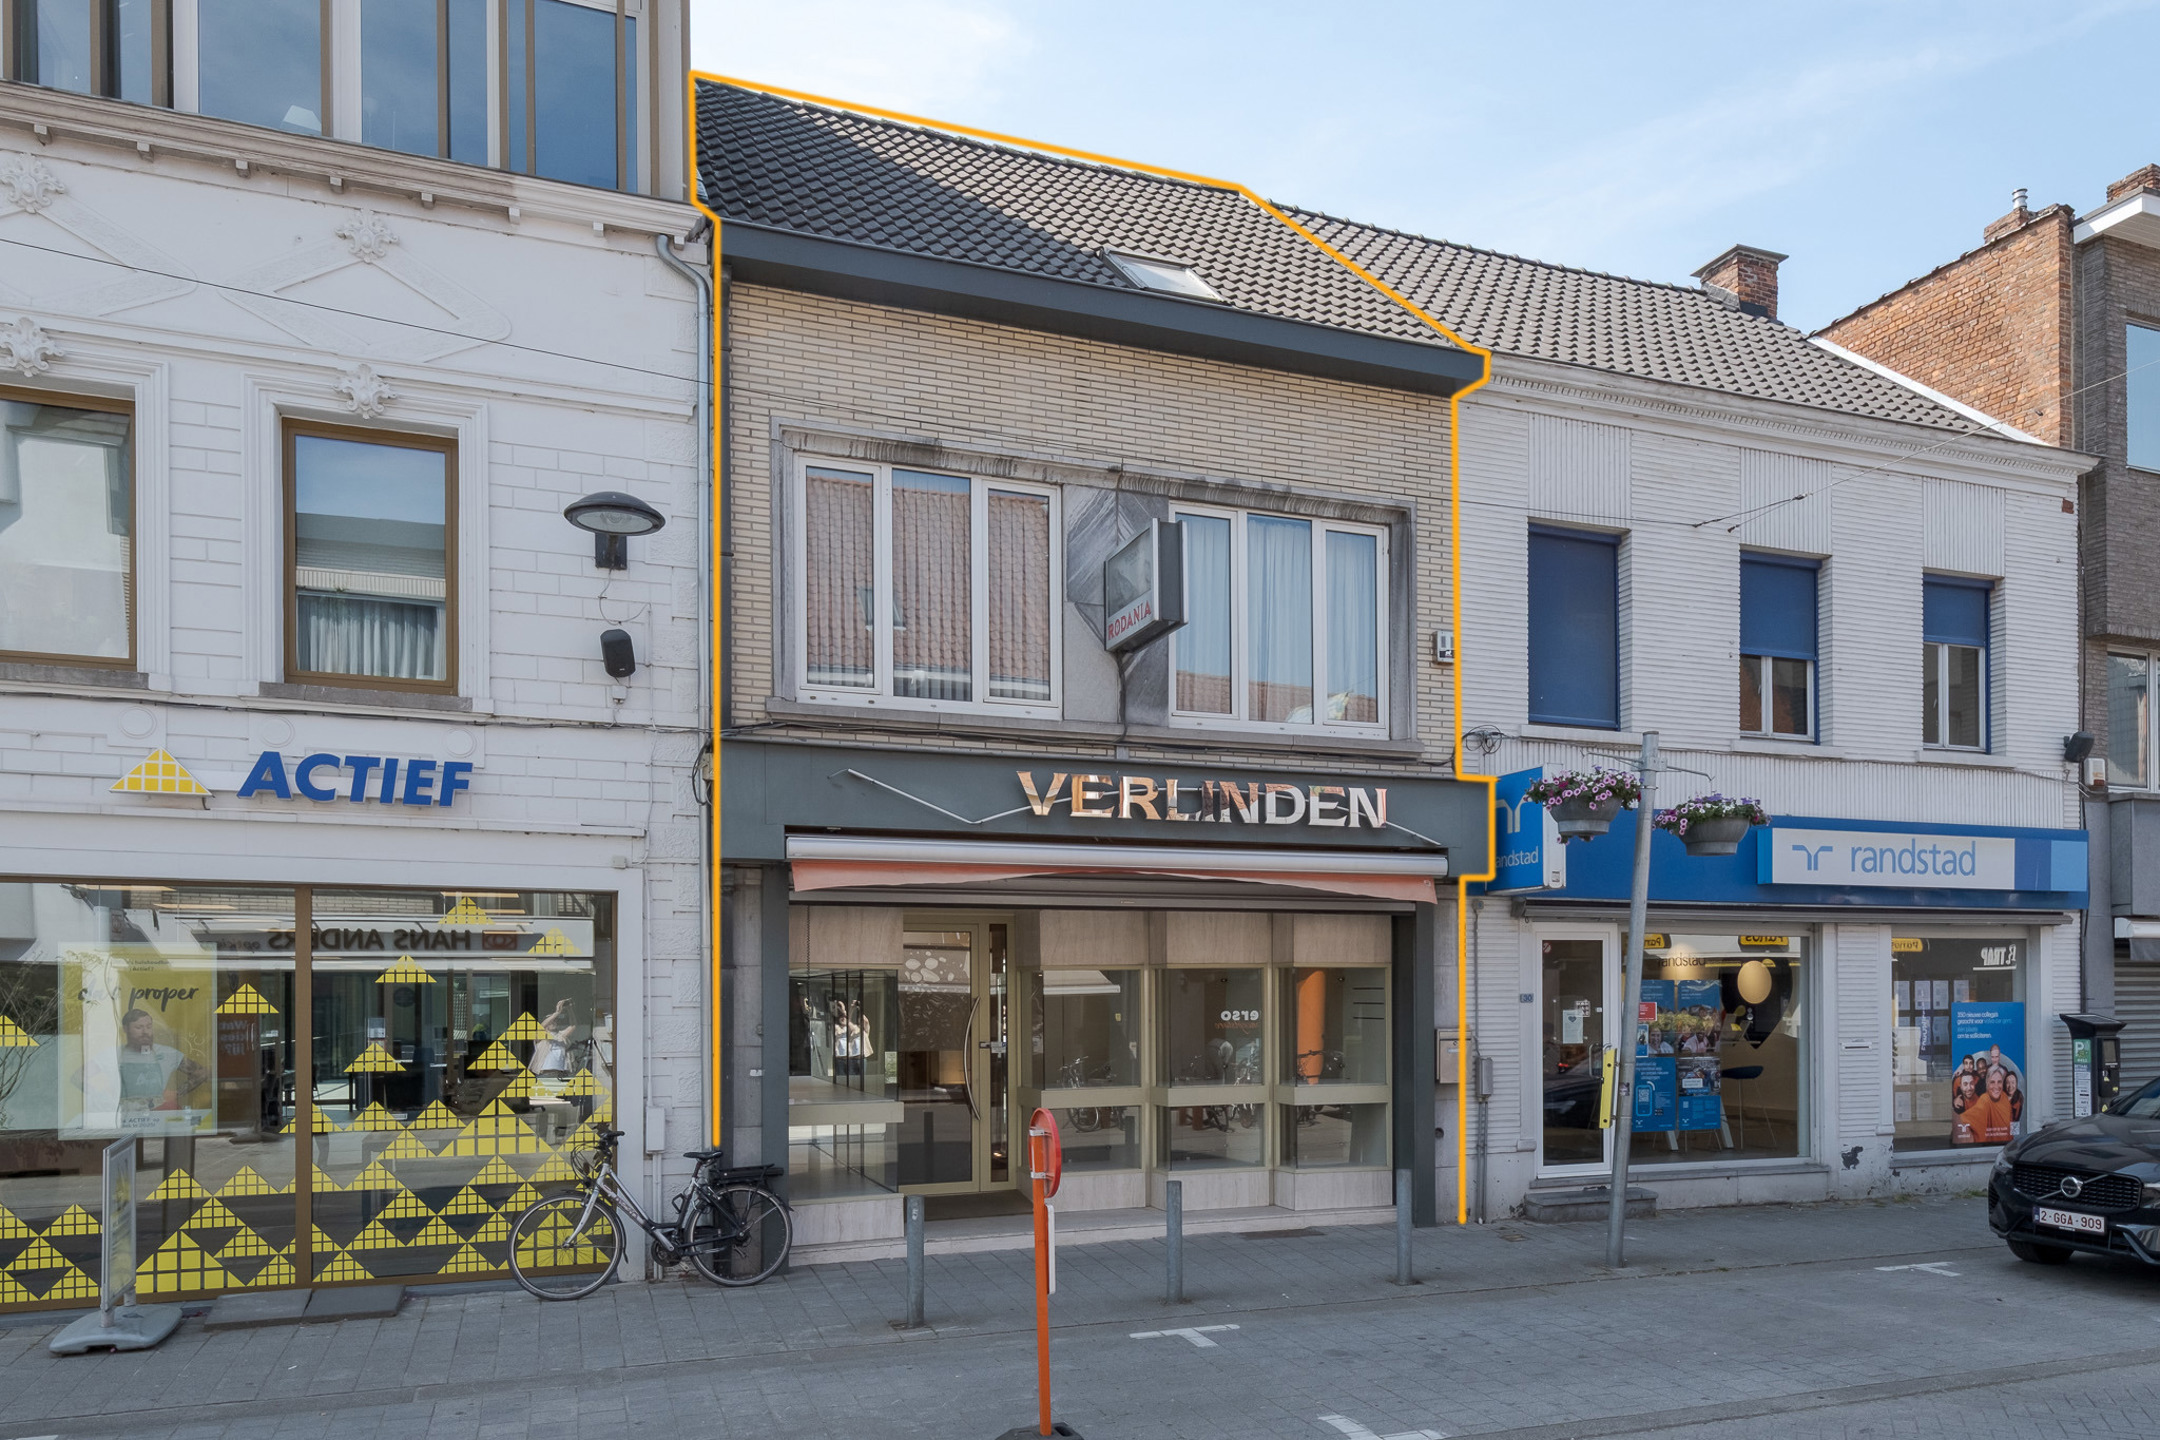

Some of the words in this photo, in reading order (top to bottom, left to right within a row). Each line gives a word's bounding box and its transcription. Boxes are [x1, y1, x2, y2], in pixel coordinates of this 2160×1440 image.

[1108, 600, 1151, 640] RODANIA
[237, 751, 473, 808] ACTIEF
[1016, 771, 1387, 828] VERLINDEN
[1495, 845, 1539, 868] andstad
[1851, 838, 1976, 876] randstad
[128, 986, 199, 1012] proper
[2041, 1210, 2102, 1230] 2-GGA-909
